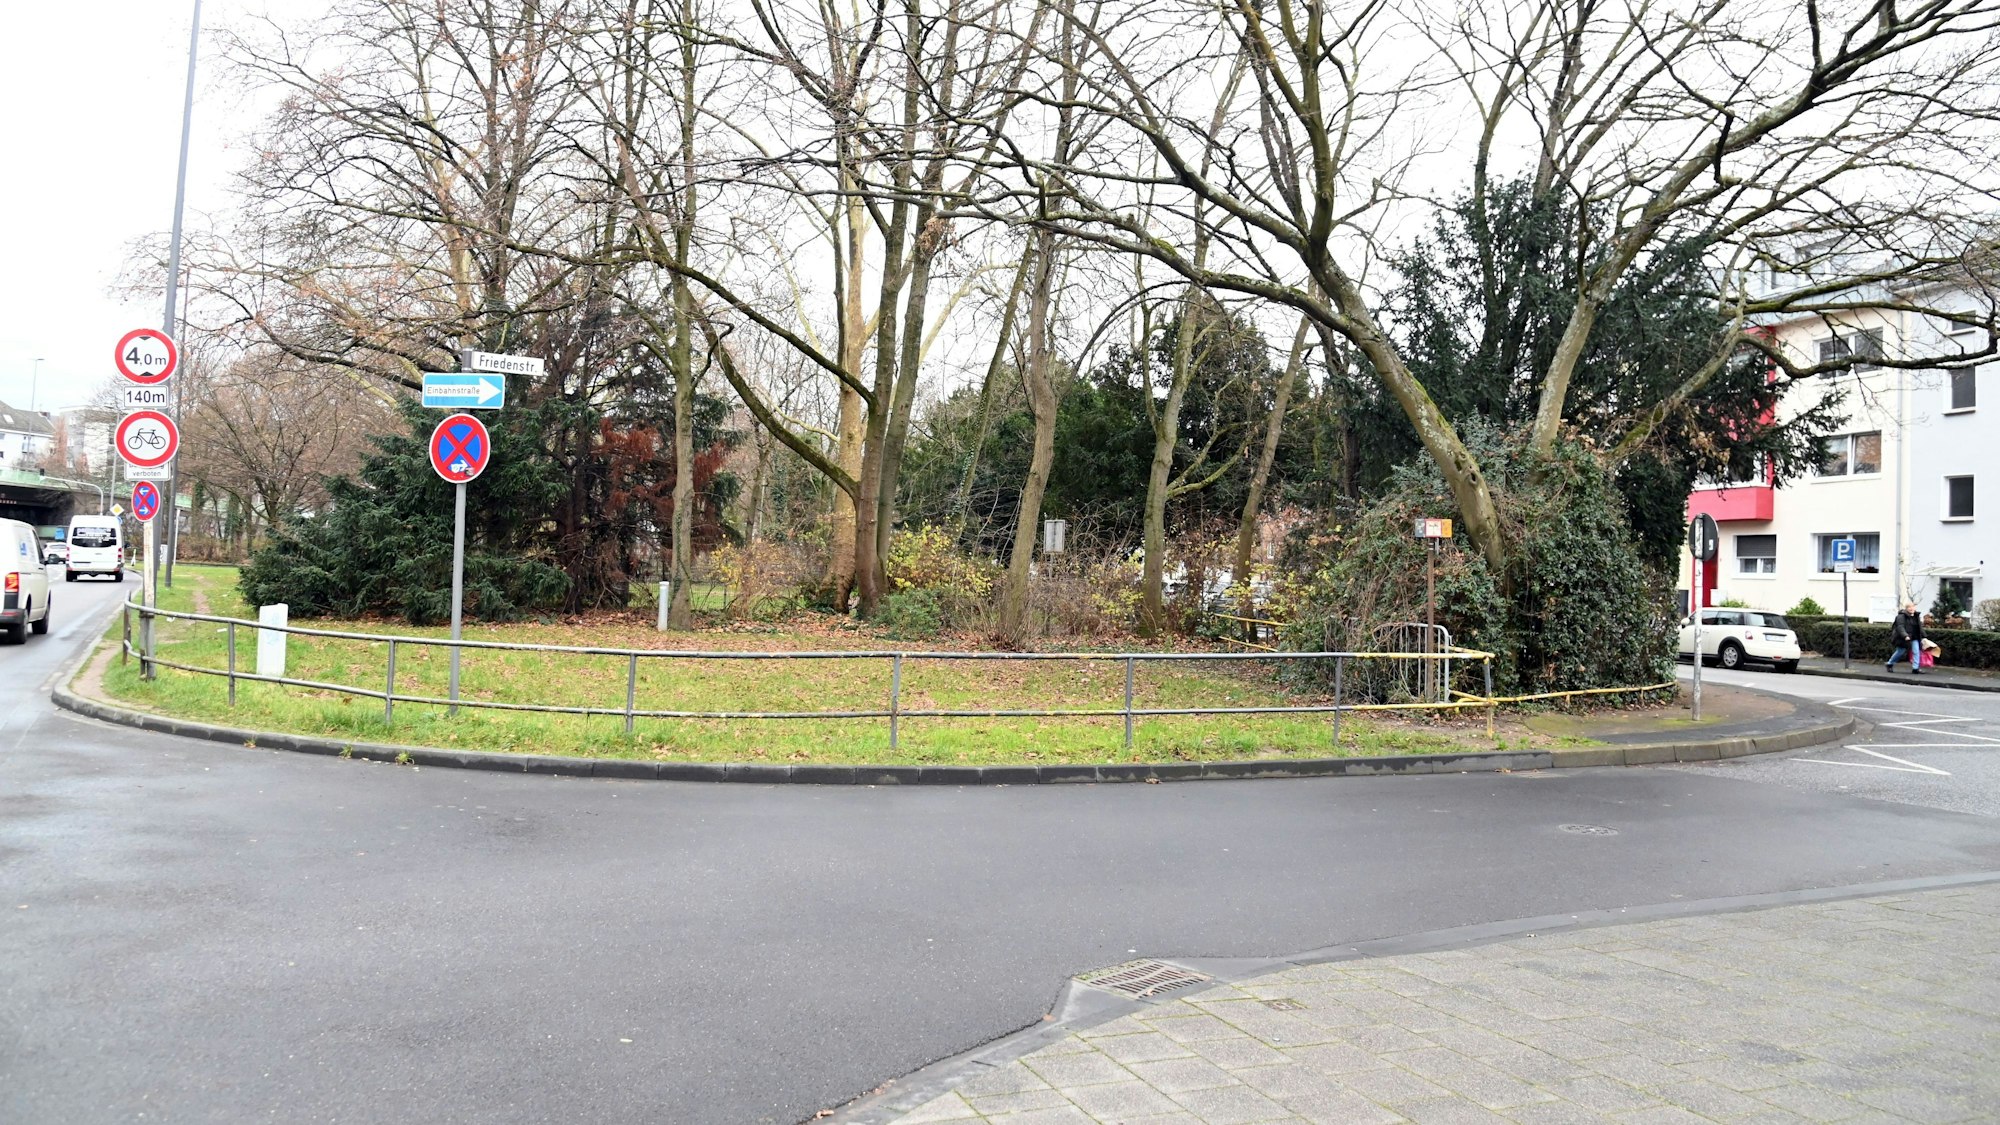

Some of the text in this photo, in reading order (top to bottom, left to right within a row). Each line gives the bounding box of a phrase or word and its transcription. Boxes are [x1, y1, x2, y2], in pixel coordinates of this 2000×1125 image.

[479, 355, 538, 373] Friedenstr.
[126, 390, 165, 403] 140m
[427, 386, 480, 395] Einbahnstraße
